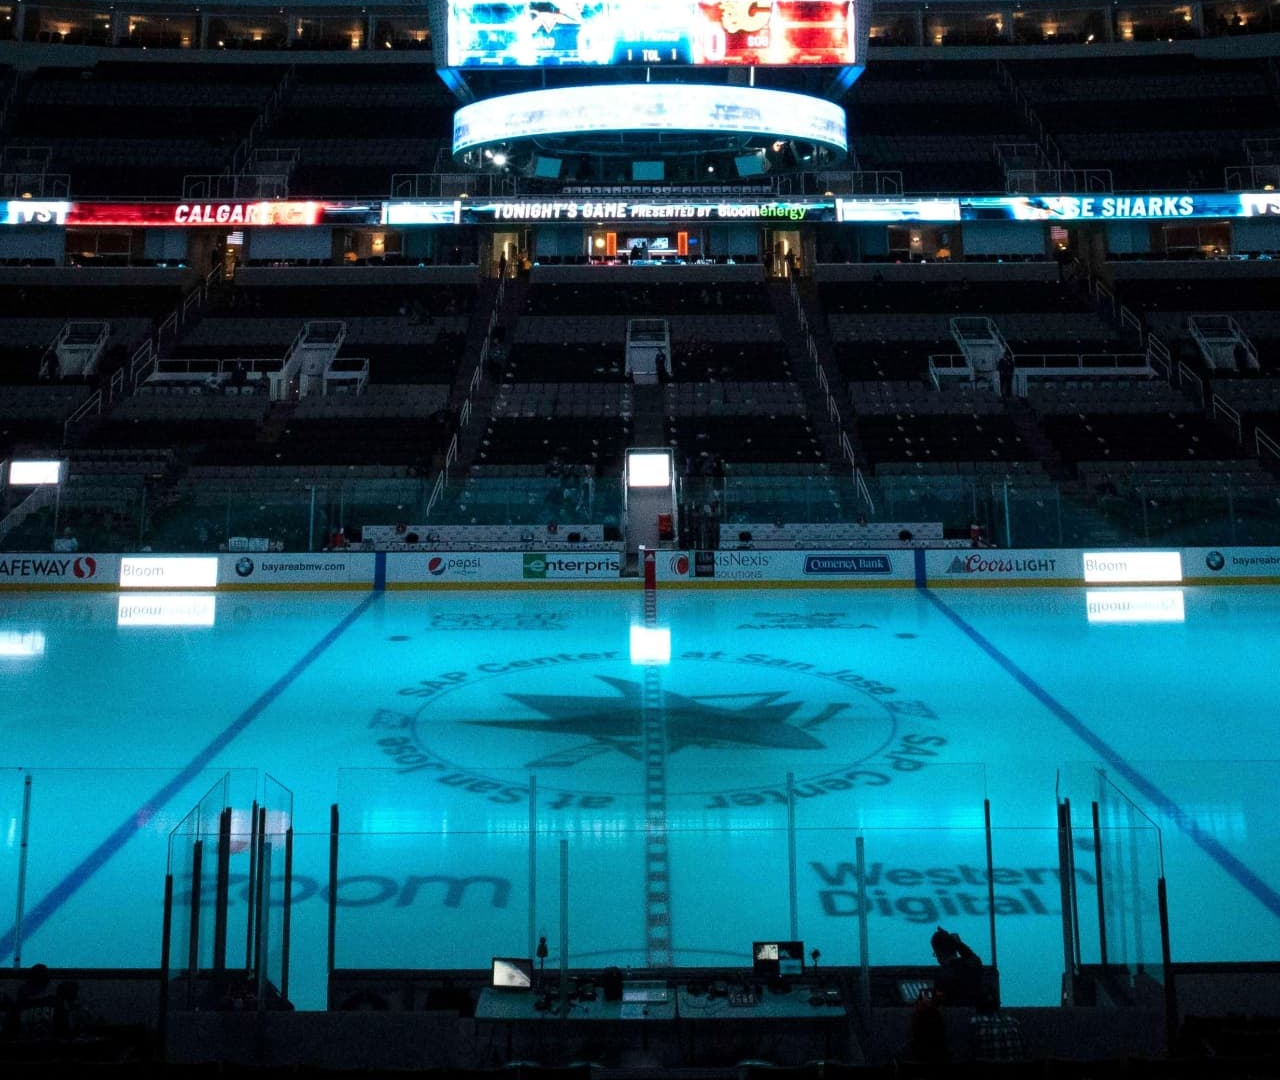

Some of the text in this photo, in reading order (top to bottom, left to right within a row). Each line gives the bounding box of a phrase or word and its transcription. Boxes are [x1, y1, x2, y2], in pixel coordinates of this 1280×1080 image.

[175, 204, 260, 224] CALGAR
[493, 203, 578, 219] TONIGHT'S
[582, 203, 627, 219] GAME
[631, 206, 694, 218] PRESENTED
[697, 206, 711, 218] BY
[1102, 196, 1194, 217] SHARKS
[261, 561, 345, 573] bayareabmw.com
[448, 557, 481, 570] pepsi
[531, 559, 620, 574] enterpris
[714, 552, 769, 567] xisNexis
[859, 558, 884, 570] Bank
[966, 553, 1056, 573] Coors LIGHT
[1086, 560, 1127, 572] Bloom
[123, 564, 164, 576] Bloom
[396, 672, 469, 697] SAP
[477, 651, 622, 673] Center
[736, 653, 816, 671] San
[817, 669, 897, 696] Jose
[810, 861, 1098, 888] Western
[163, 874, 513, 909] zoom
[819, 887, 1051, 925] Digital
